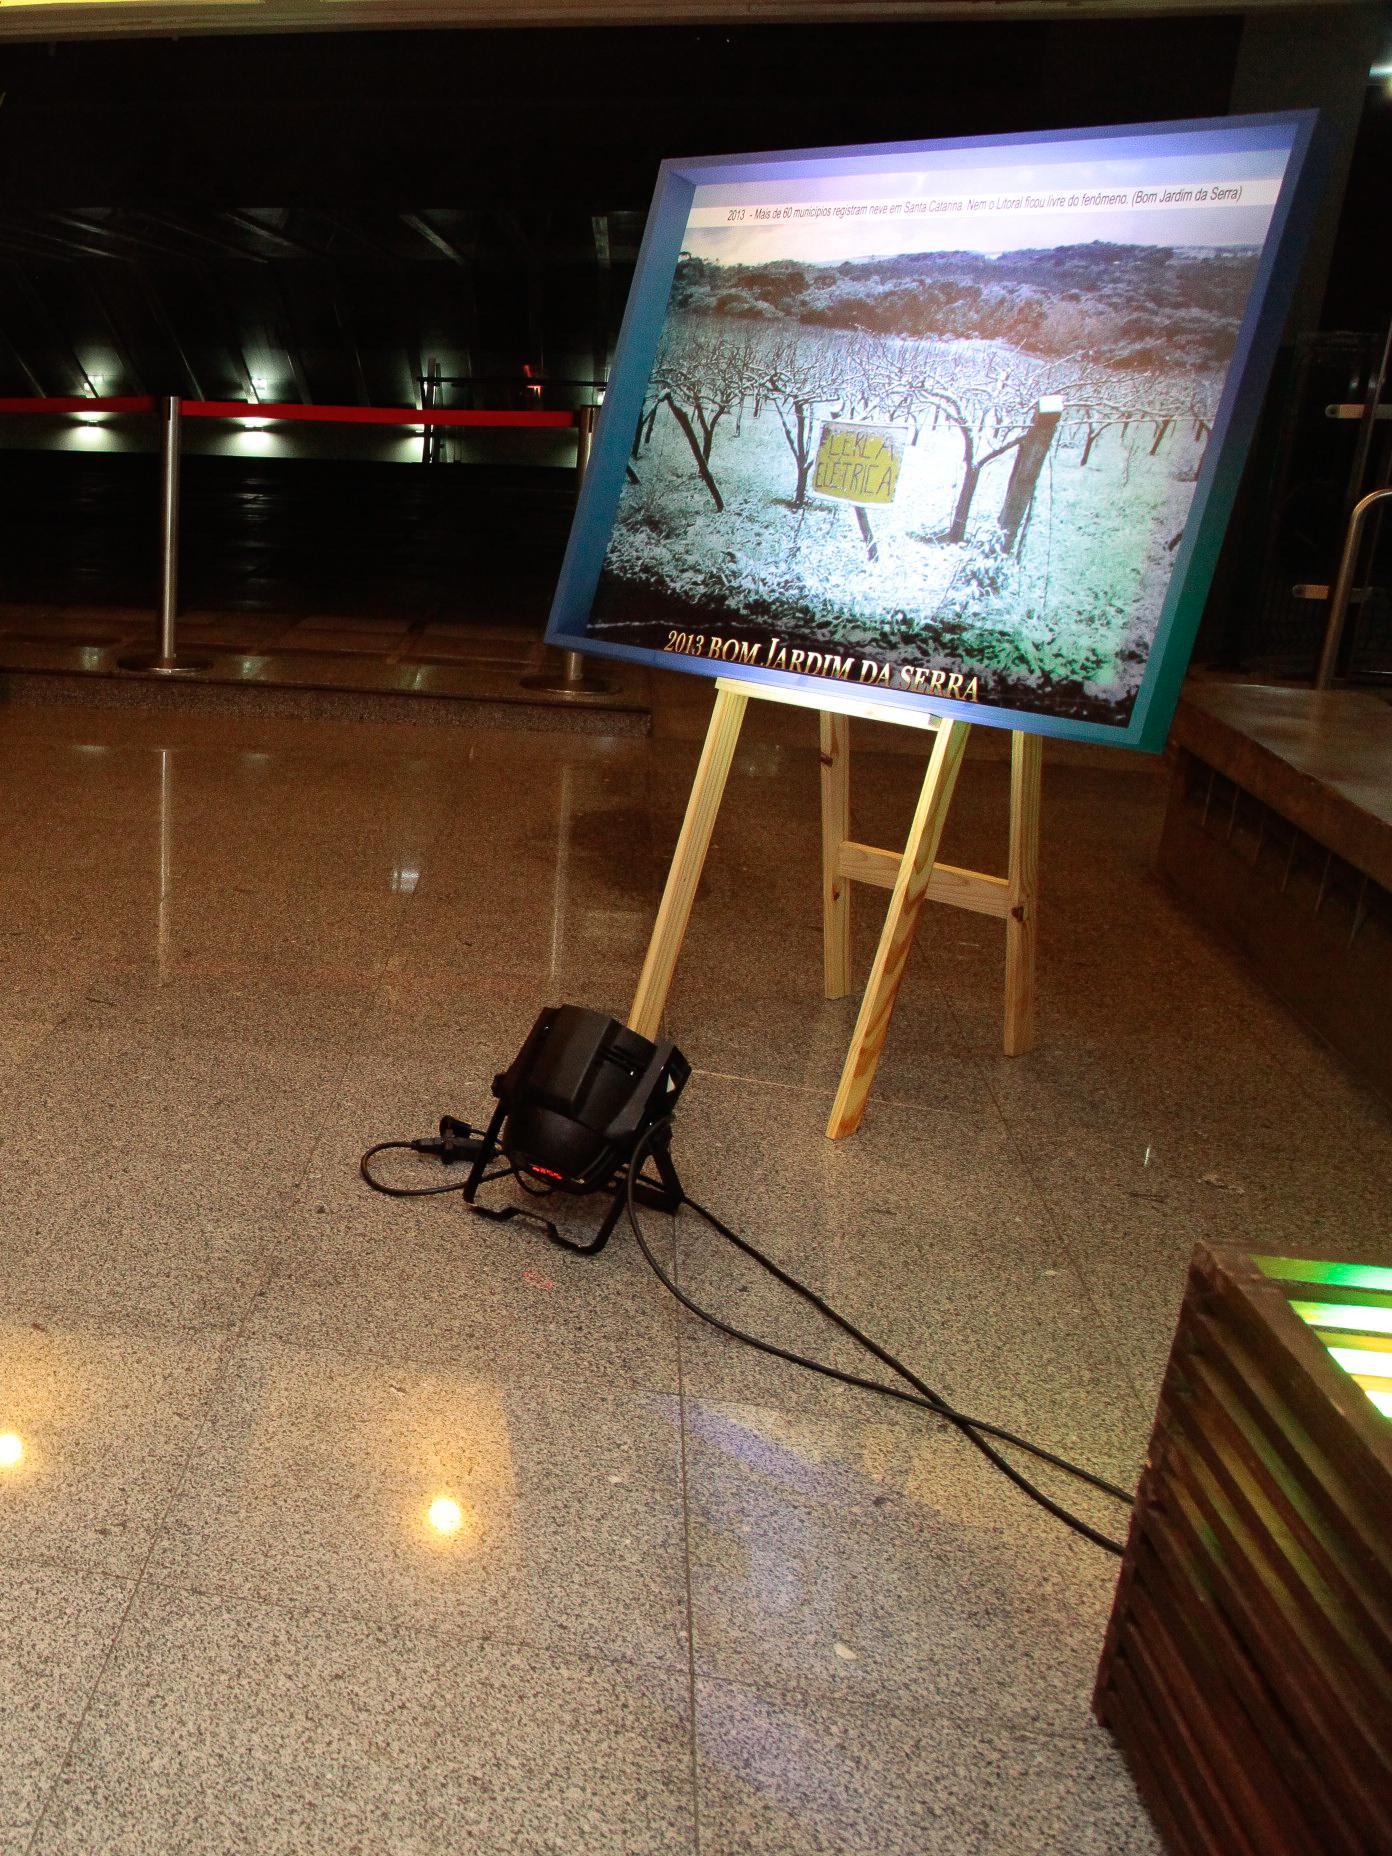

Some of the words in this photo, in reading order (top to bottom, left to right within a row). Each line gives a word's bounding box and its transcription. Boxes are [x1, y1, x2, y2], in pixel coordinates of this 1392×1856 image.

[727, 209, 746, 221] 2013
[754, 208, 771, 220] Mais
[772, 208, 781, 219] de
[782, 206, 793, 218] 60
[832, 204, 868, 219] registram
[868, 204, 888, 215] neve
[889, 203, 903, 214] em
[903, 201, 927, 214] Santa
[967, 198, 987, 211] Nem
[988, 200, 995, 210] o
[996, 196, 1024, 210] Litoral
[1024, 195, 1046, 209] ficou
[1046, 194, 1065, 208] livre
[1067, 193, 1080, 207] do
[1081, 192, 1128, 206] fenômeno.
[1131, 190, 1158, 208] (Bom
[1159, 187, 1193, 203] Jardim
[1194, 187, 1208, 201] da
[1210, 185, 1243, 203] Serra)
[664, 630, 705, 656] 2013
[708, 636, 761, 666] BOM
[859, 659, 891, 688] DA
[897, 664, 980, 703] SERRA
